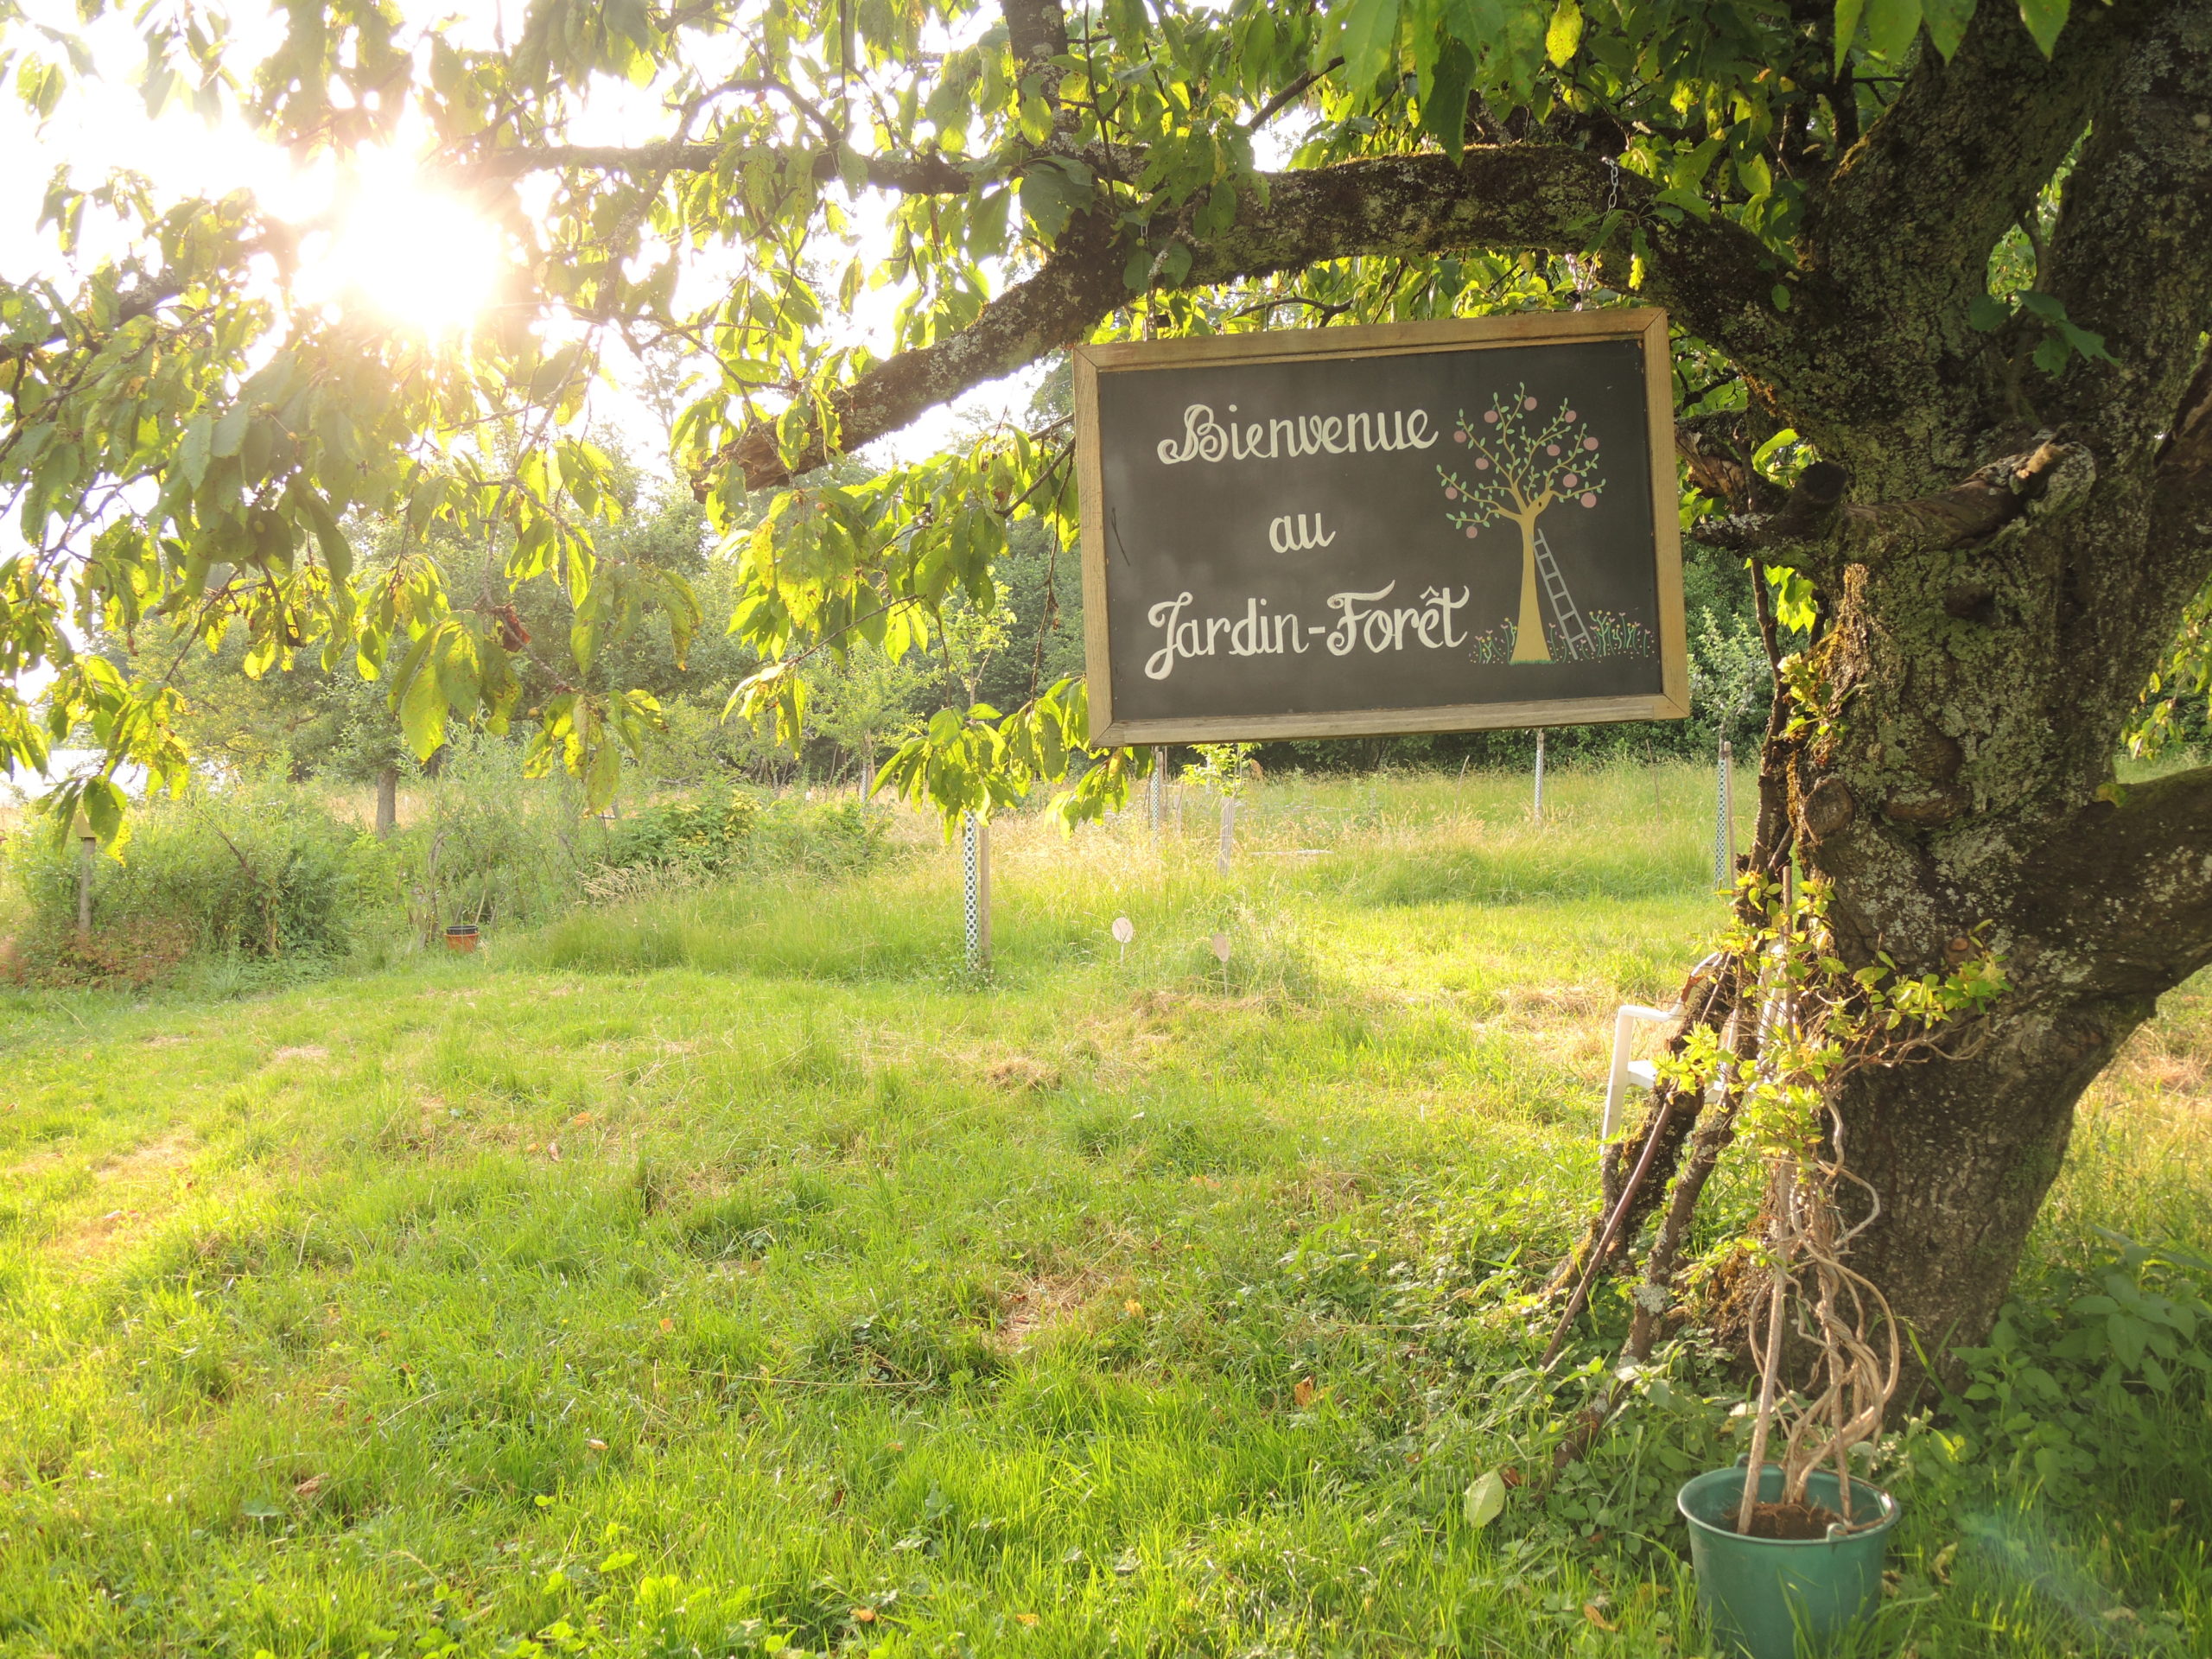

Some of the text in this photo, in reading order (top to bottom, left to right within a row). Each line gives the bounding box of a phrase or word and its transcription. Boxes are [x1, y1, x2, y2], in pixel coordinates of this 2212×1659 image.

[1157, 404, 1439, 465] Bienvenue
[1268, 512, 1336, 554] au
[1144, 579, 1470, 681] Jardin-Forêt
